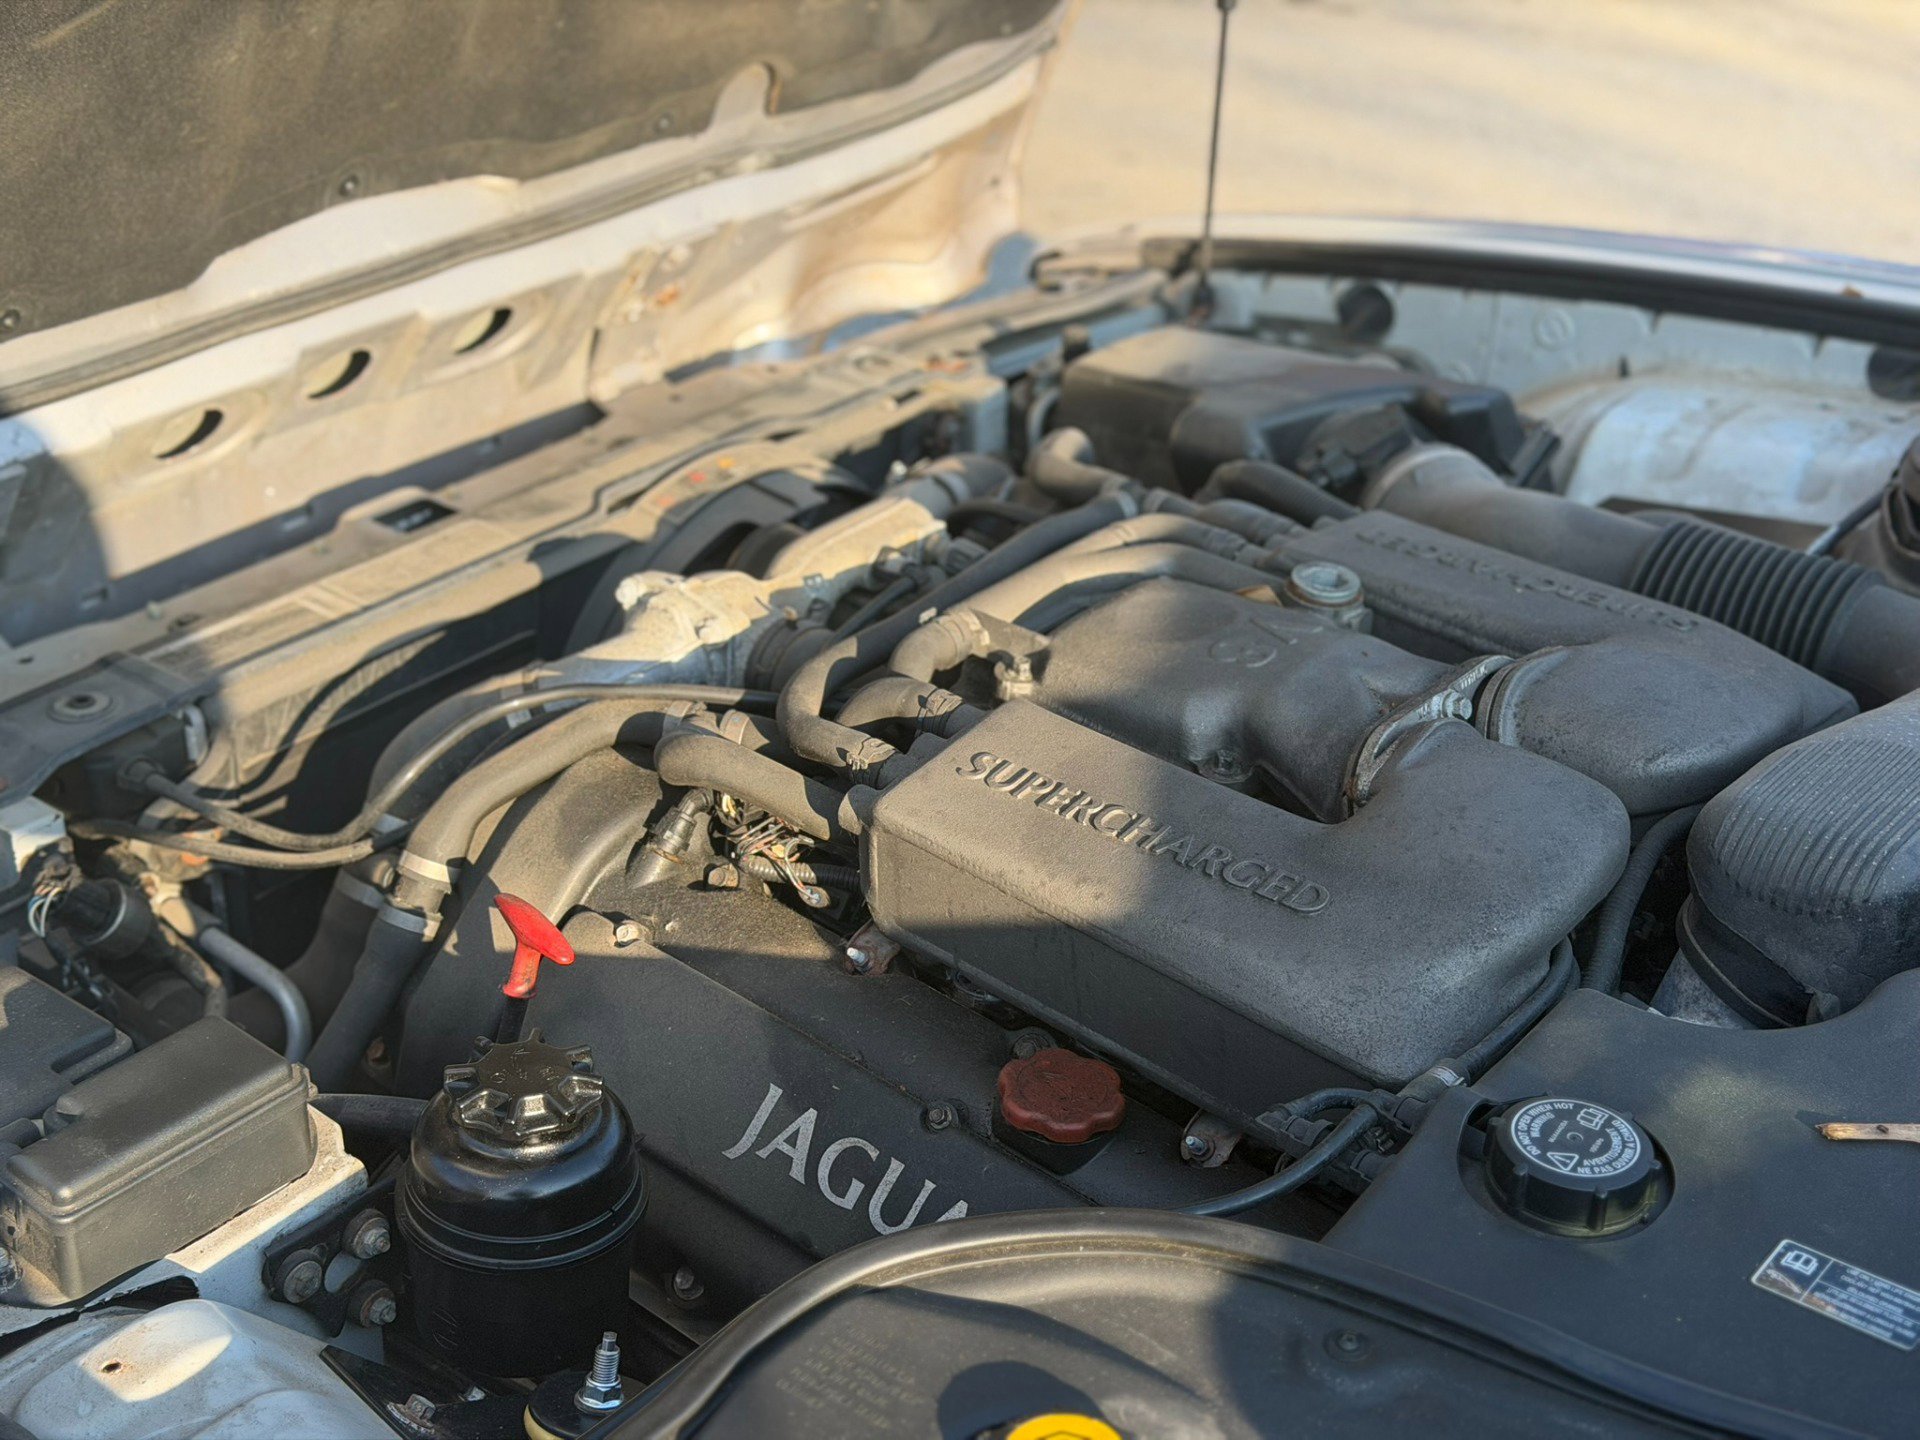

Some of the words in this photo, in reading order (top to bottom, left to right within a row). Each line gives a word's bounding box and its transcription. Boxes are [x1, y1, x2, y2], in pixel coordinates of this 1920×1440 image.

[956, 751, 1331, 916] SUPERCHARGED
[1528, 1103, 1554, 1117] WHEN
[1553, 1102, 1575, 1110] HOT
[1518, 1114, 1532, 1132] OPEN
[1529, 1112, 1556, 1138] WARNING
[1518, 1131, 1532, 1146] NOT
[1526, 1145, 1541, 1156] DO
[722, 1082, 969, 1236] JAGU
[1577, 1166, 1592, 1174] NE
[1594, 1164, 1614, 1174] PAS
